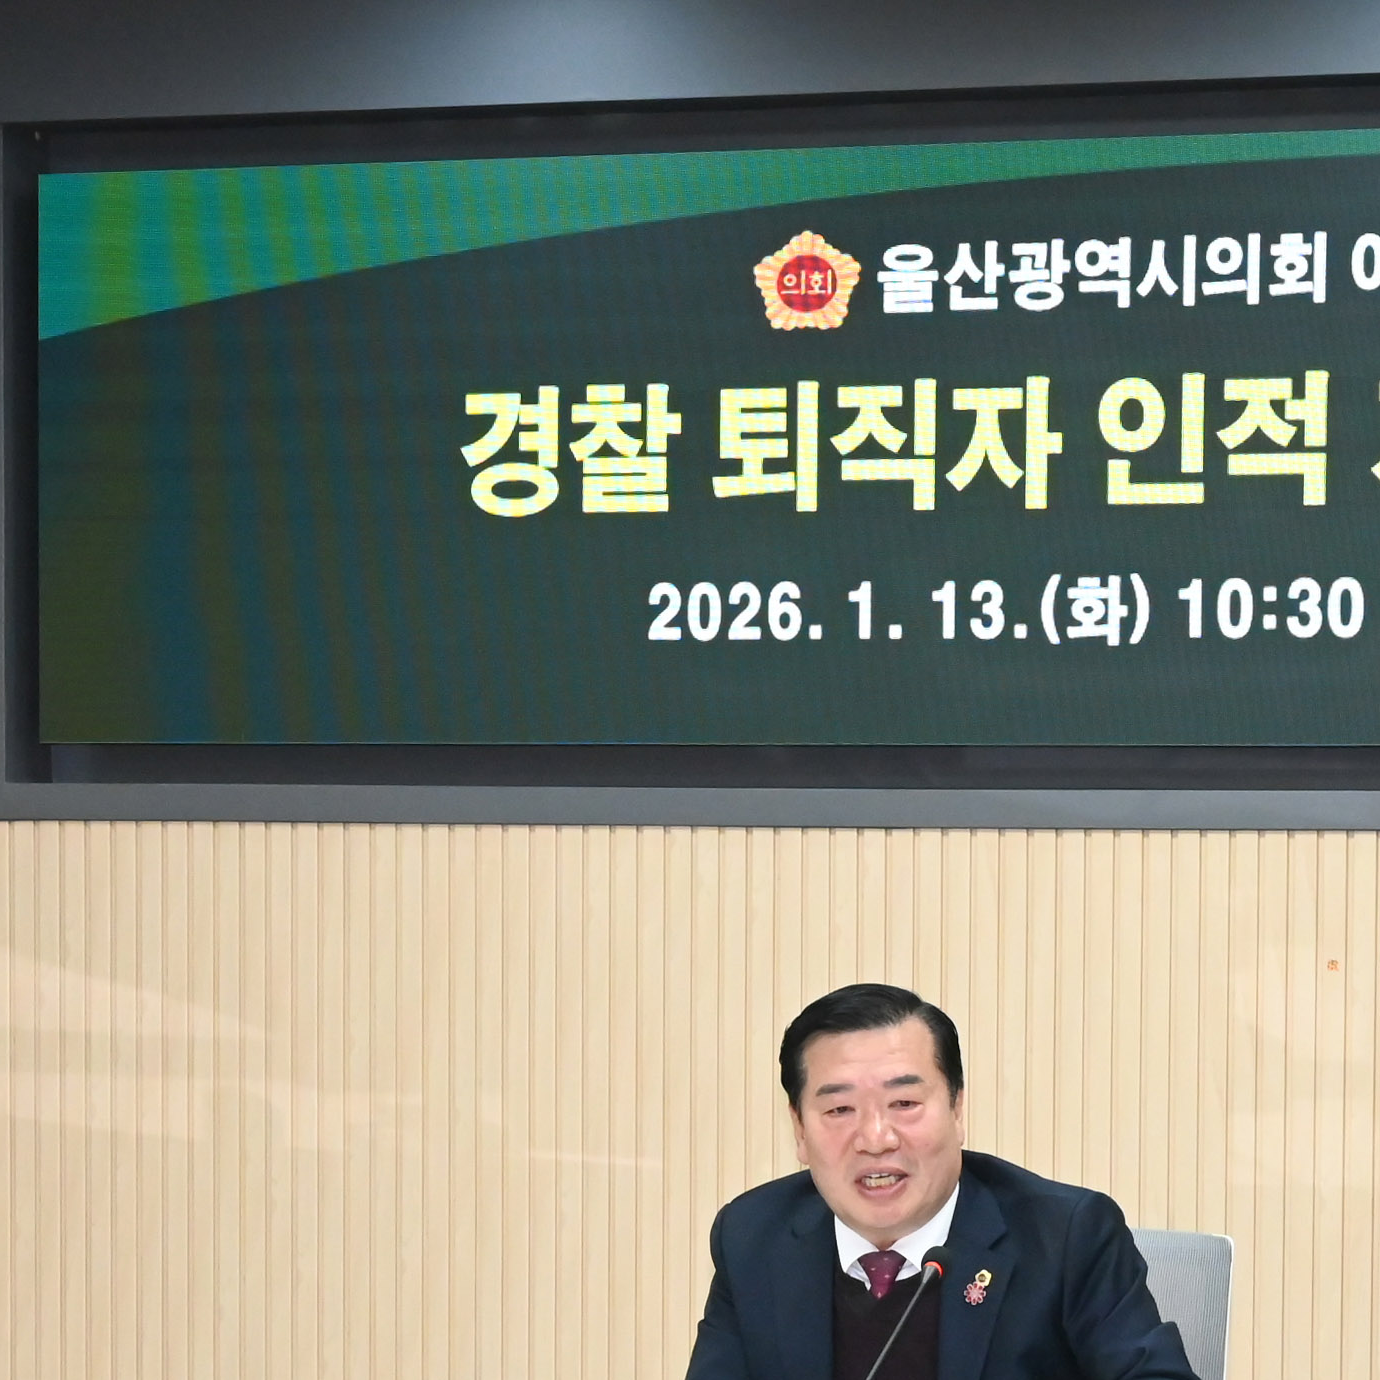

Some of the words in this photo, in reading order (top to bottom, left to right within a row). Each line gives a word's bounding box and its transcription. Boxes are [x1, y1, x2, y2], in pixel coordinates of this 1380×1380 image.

[780, 268, 833, 295] 의회
[876, 230, 1328, 314] 울산광역시의회
[459, 382, 682, 518] 경찰
[711, 375, 1063, 513] 퇴직자
[1096, 369, 1330, 506] 인적
[647, 580, 823, 642] 2026.
[848, 580, 903, 640] 1.
[1178, 576, 1365, 640] 10:30
